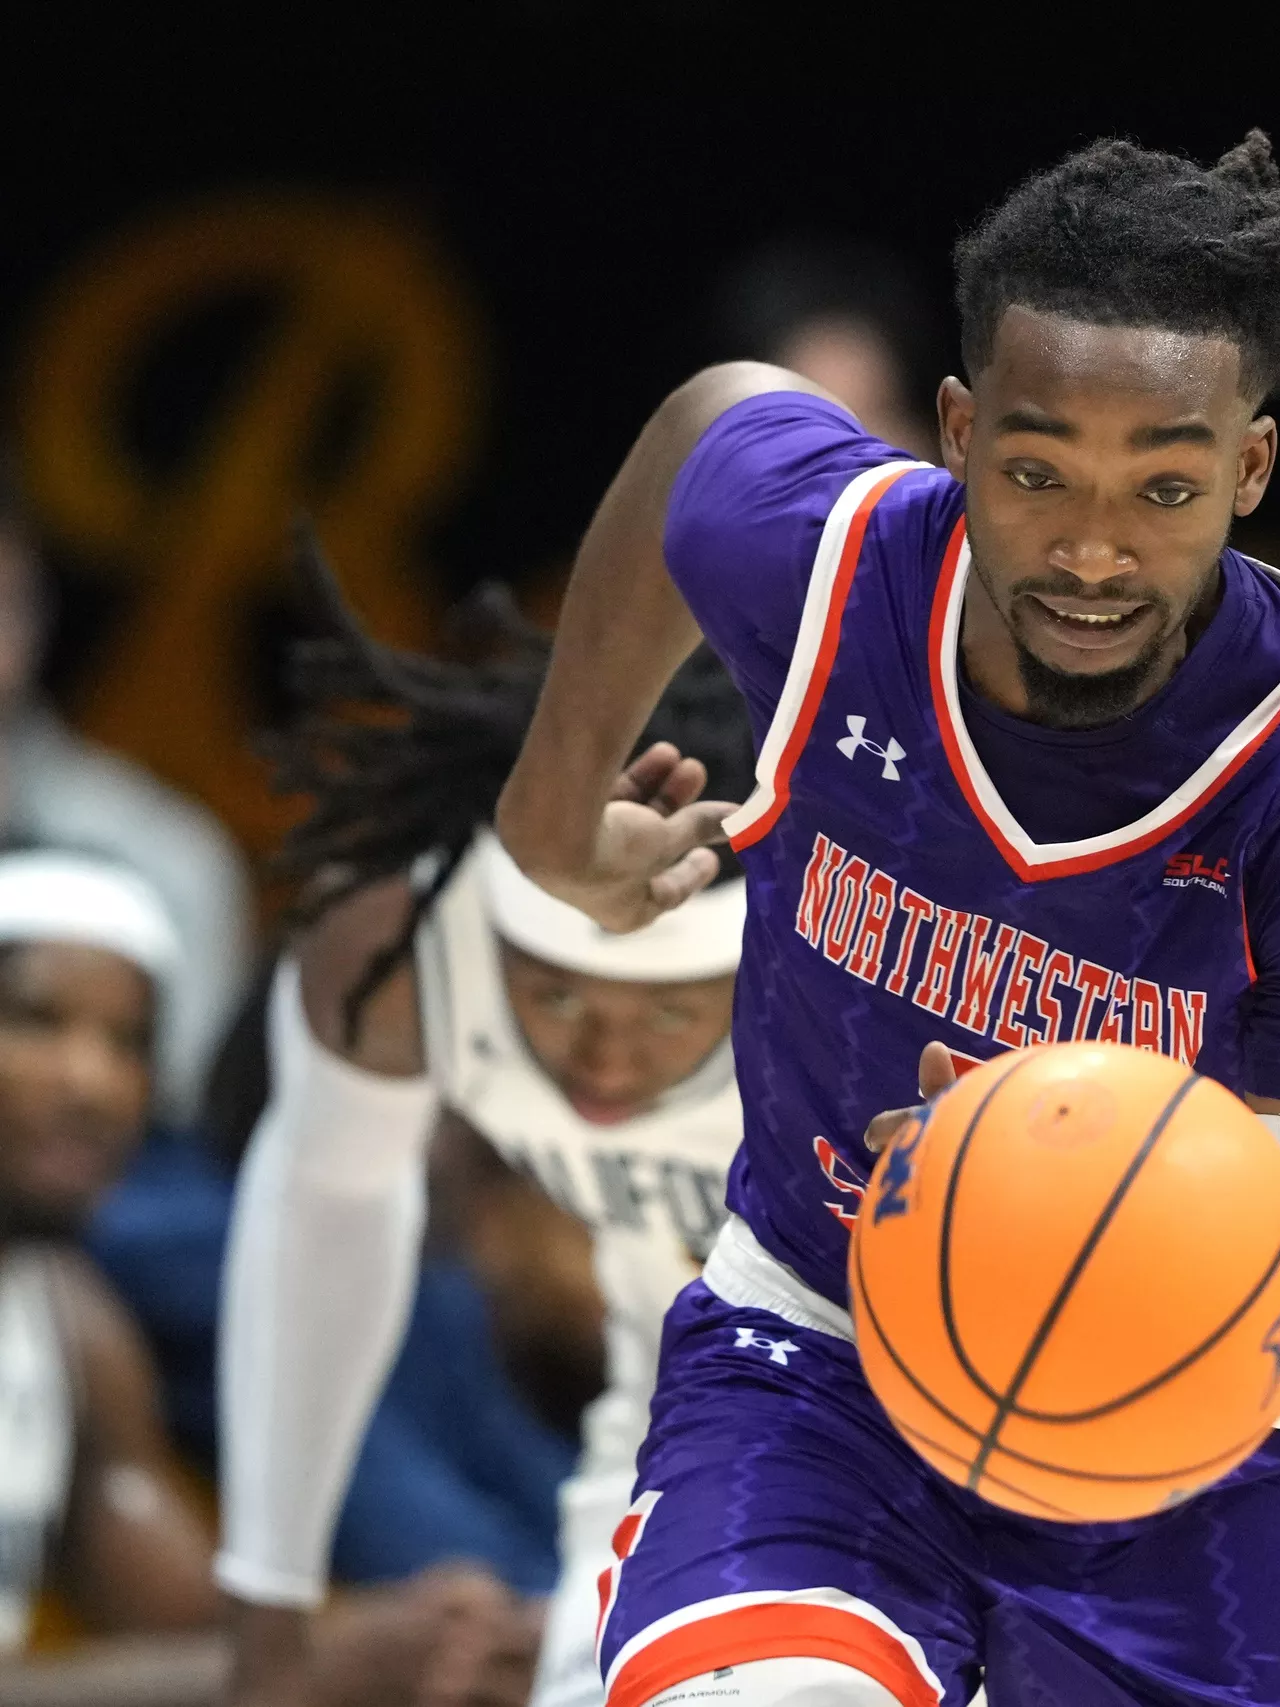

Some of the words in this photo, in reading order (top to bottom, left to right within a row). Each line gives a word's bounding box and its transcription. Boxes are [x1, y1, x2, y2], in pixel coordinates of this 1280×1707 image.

[1165, 853, 1229, 883] SLC
[1162, 876, 1229, 899] SOUTHLAN
[795, 832, 1208, 1067] NORTHWESTERN
[688, 1688, 741, 1698] ARMOUR
